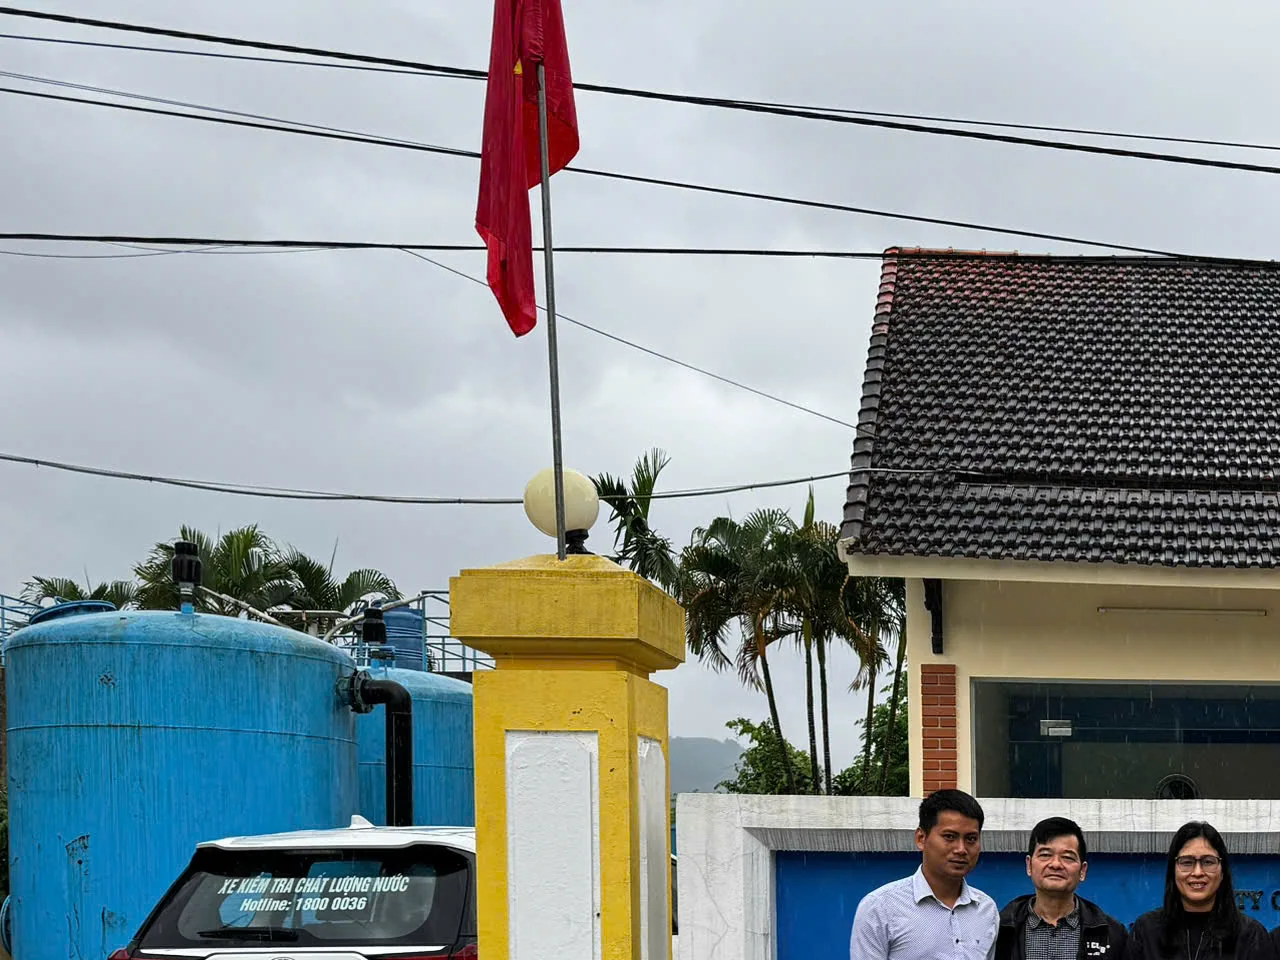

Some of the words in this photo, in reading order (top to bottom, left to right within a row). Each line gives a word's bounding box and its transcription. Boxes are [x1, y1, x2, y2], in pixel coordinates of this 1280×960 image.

[217, 878, 239, 894] XE
[270, 877, 292, 894] TRA
[295, 872, 330, 894] CHẤT
[329, 875, 371, 896] LƯỢNG
[372, 873, 410, 893] NƯỚC
[240, 898, 292, 912] Hotline:
[295, 897, 328, 911] 1800
[331, 897, 367, 911] 0036
[1235, 889, 1264, 910] TY
